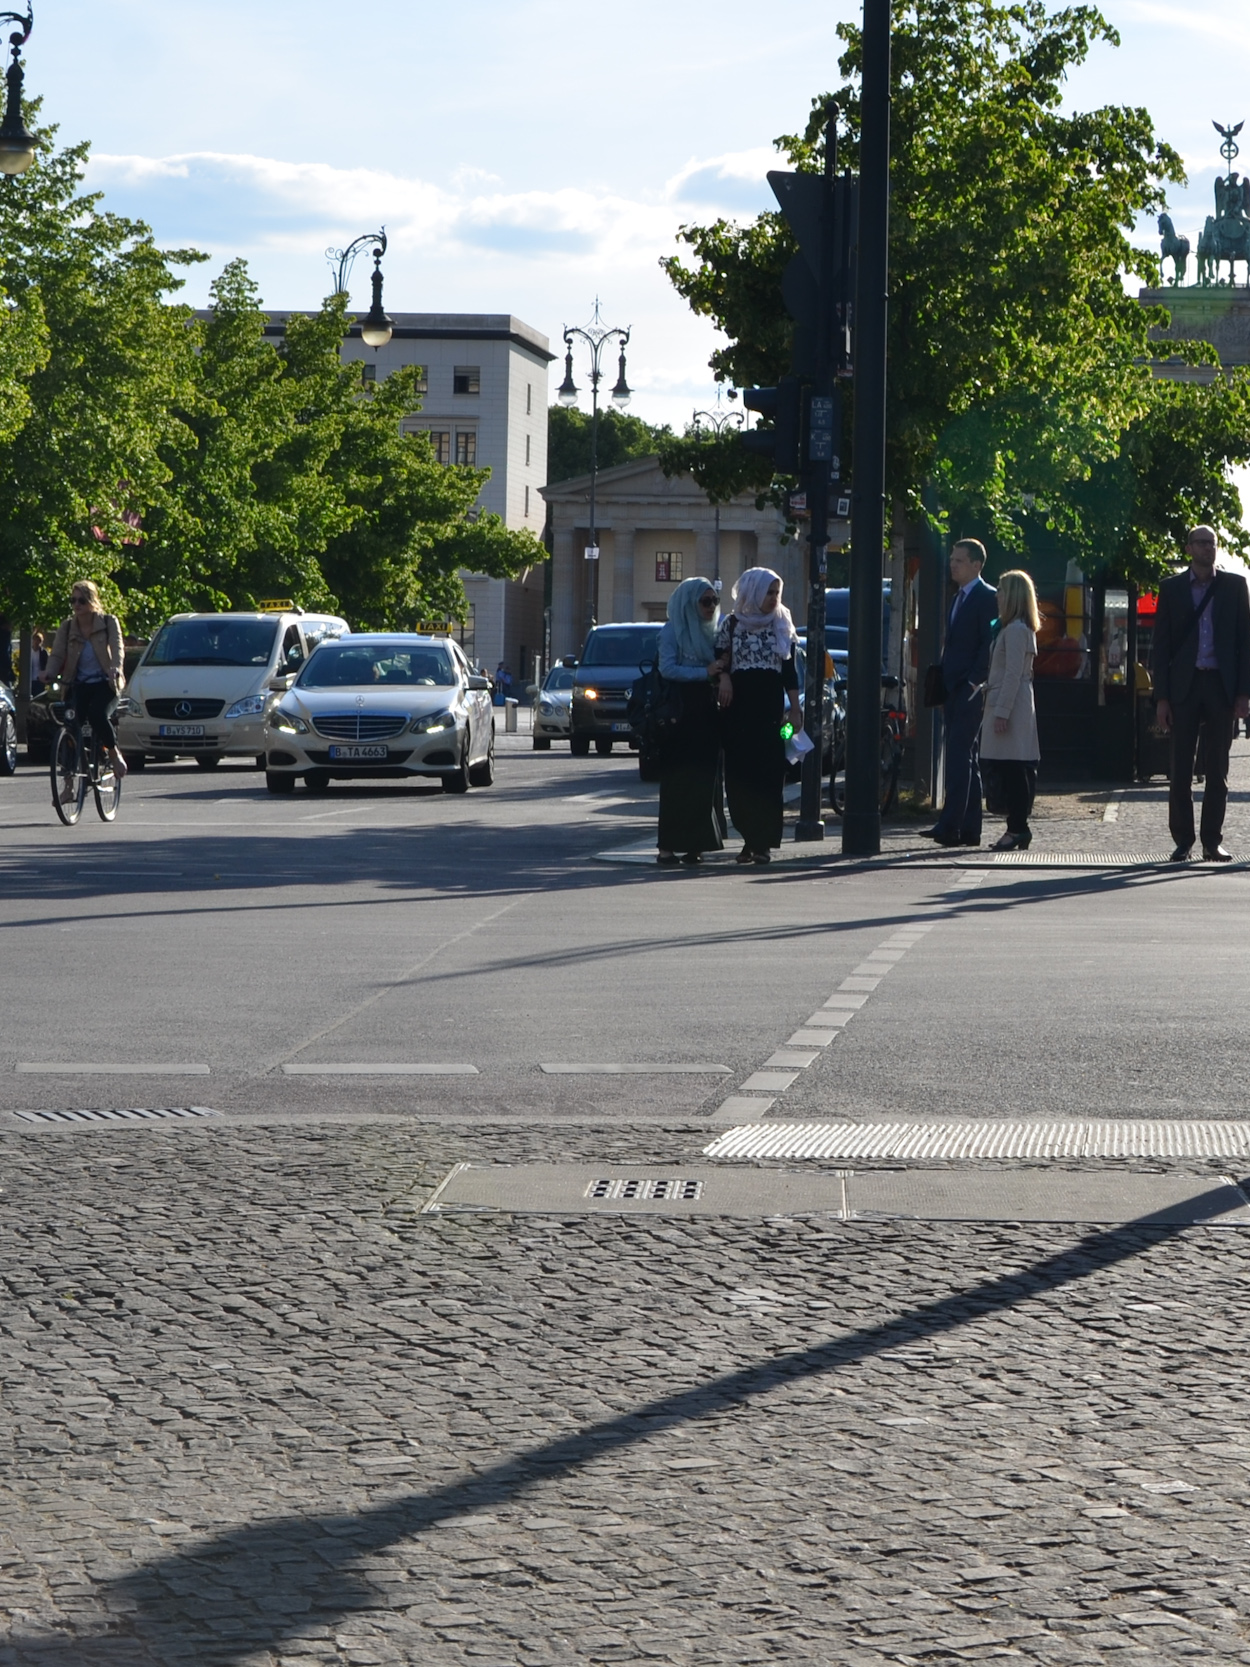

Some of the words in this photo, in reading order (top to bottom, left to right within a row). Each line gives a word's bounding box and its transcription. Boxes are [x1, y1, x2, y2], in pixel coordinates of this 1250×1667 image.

[422, 622, 446, 630] TAXI
[335, 747, 342, 756] B
[348, 747, 360, 756] TA
[362, 747, 386, 756] 4663
